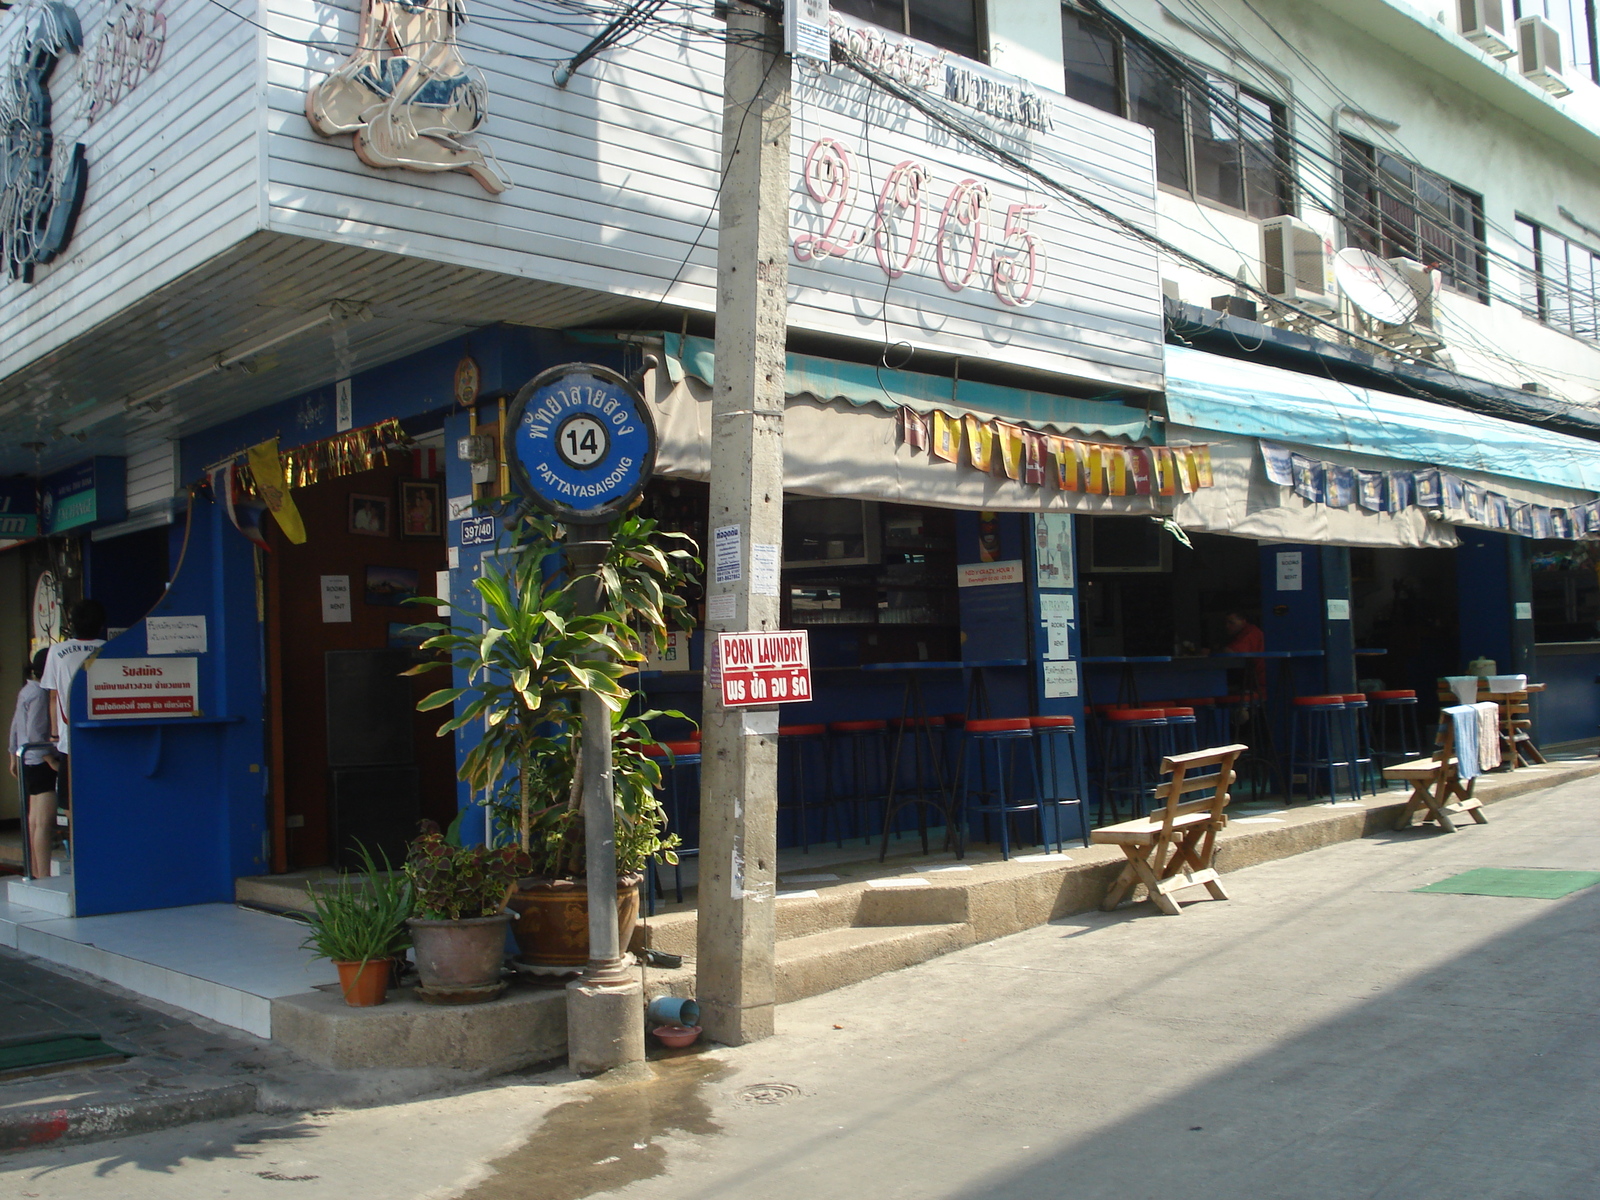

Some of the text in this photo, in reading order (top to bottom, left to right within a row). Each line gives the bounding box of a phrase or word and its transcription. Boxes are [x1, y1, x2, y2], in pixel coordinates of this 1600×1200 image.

[793, 137, 1050, 307] 2005
[524, 386, 635, 439] พัทยาสายสอง
[566, 428, 598, 456] 14
[536, 456, 633, 498] PATTAYASAISONG
[464, 523, 492, 539] 397/40
[57, 644, 82, 659] BAYERN
[724, 638, 754, 665] PORN
[757, 636, 803, 663] LAUNDRY
[122, 664, 163, 677] รับสมัคร
[726, 669, 808, 701] พร ซัก อบ รีด
